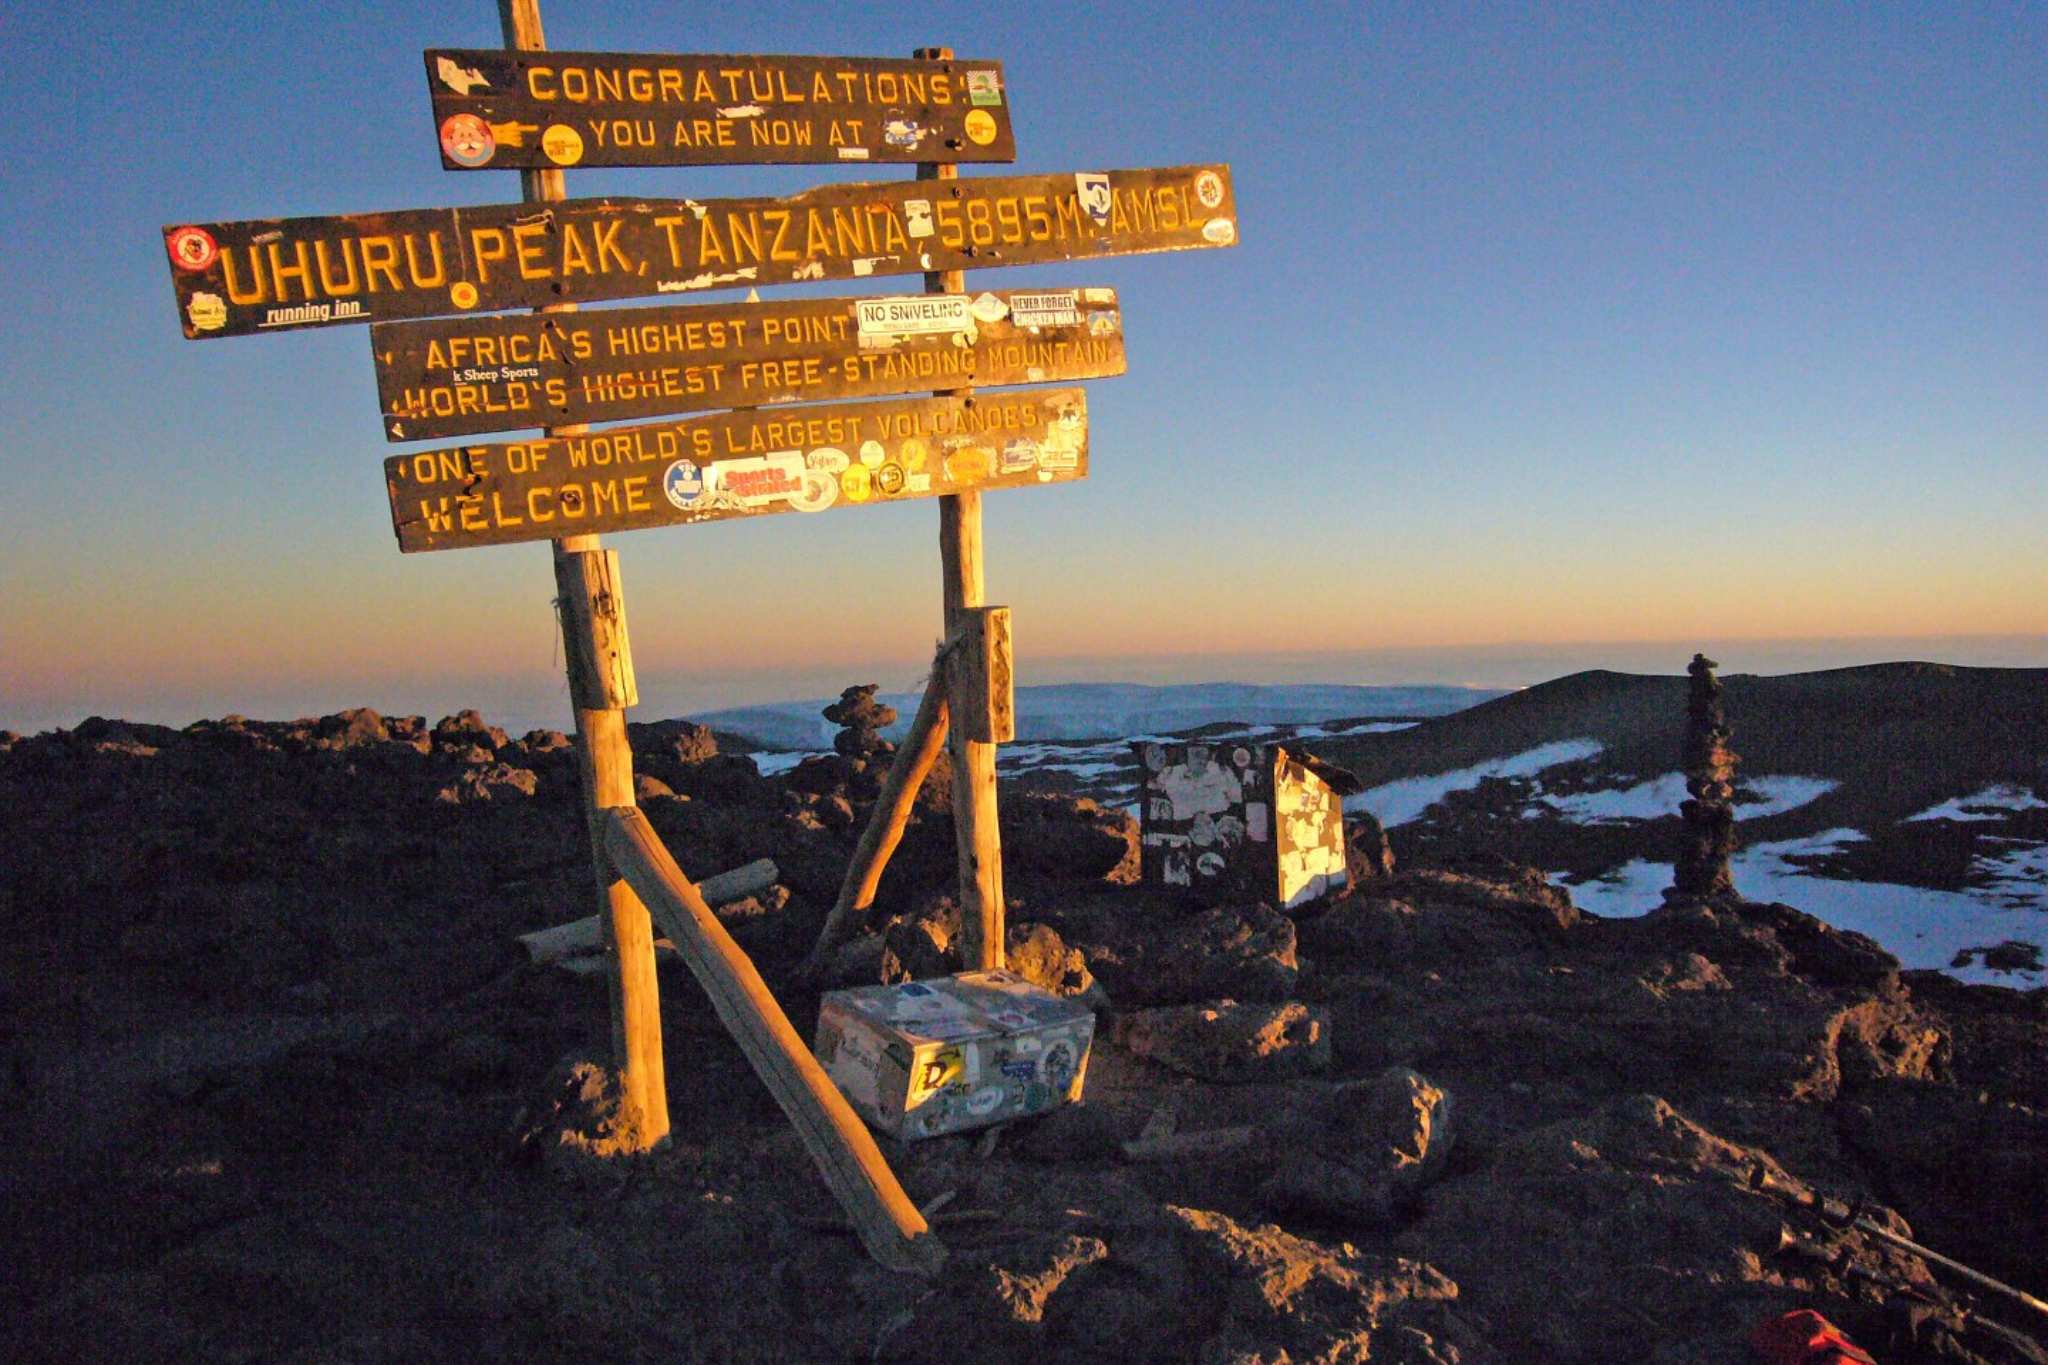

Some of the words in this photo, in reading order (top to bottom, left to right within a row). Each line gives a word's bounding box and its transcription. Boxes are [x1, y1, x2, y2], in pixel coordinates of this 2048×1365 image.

[590, 119, 656, 147] YOU
[674, 119, 736, 147] ARE
[750, 119, 812, 147] NOW
[829, 119, 864, 147] AT
[220, 228, 448, 305] UHURU
[266, 302, 330, 322] running
[335, 299, 361, 316] inn
[864, 305, 886, 322] NO
[890, 302, 963, 321] SNIVELING
[1012, 296, 1040, 310] NEVER
[1041, 295, 1073, 309] FORGET
[608, 319, 747, 357] HIGHEST
[763, 312, 849, 345] POINT
[464, 369, 498, 384] Sheep
[501, 366, 539, 382] Sports
[582, 364, 725, 404] HIGHEST
[987, 341, 1110, 372] MOUNTAIN
[413, 448, 489, 484] ONE
[507, 442, 551, 474] OF
[726, 415, 864, 454] LARGEST
[420, 474, 653, 533] WELCOME
